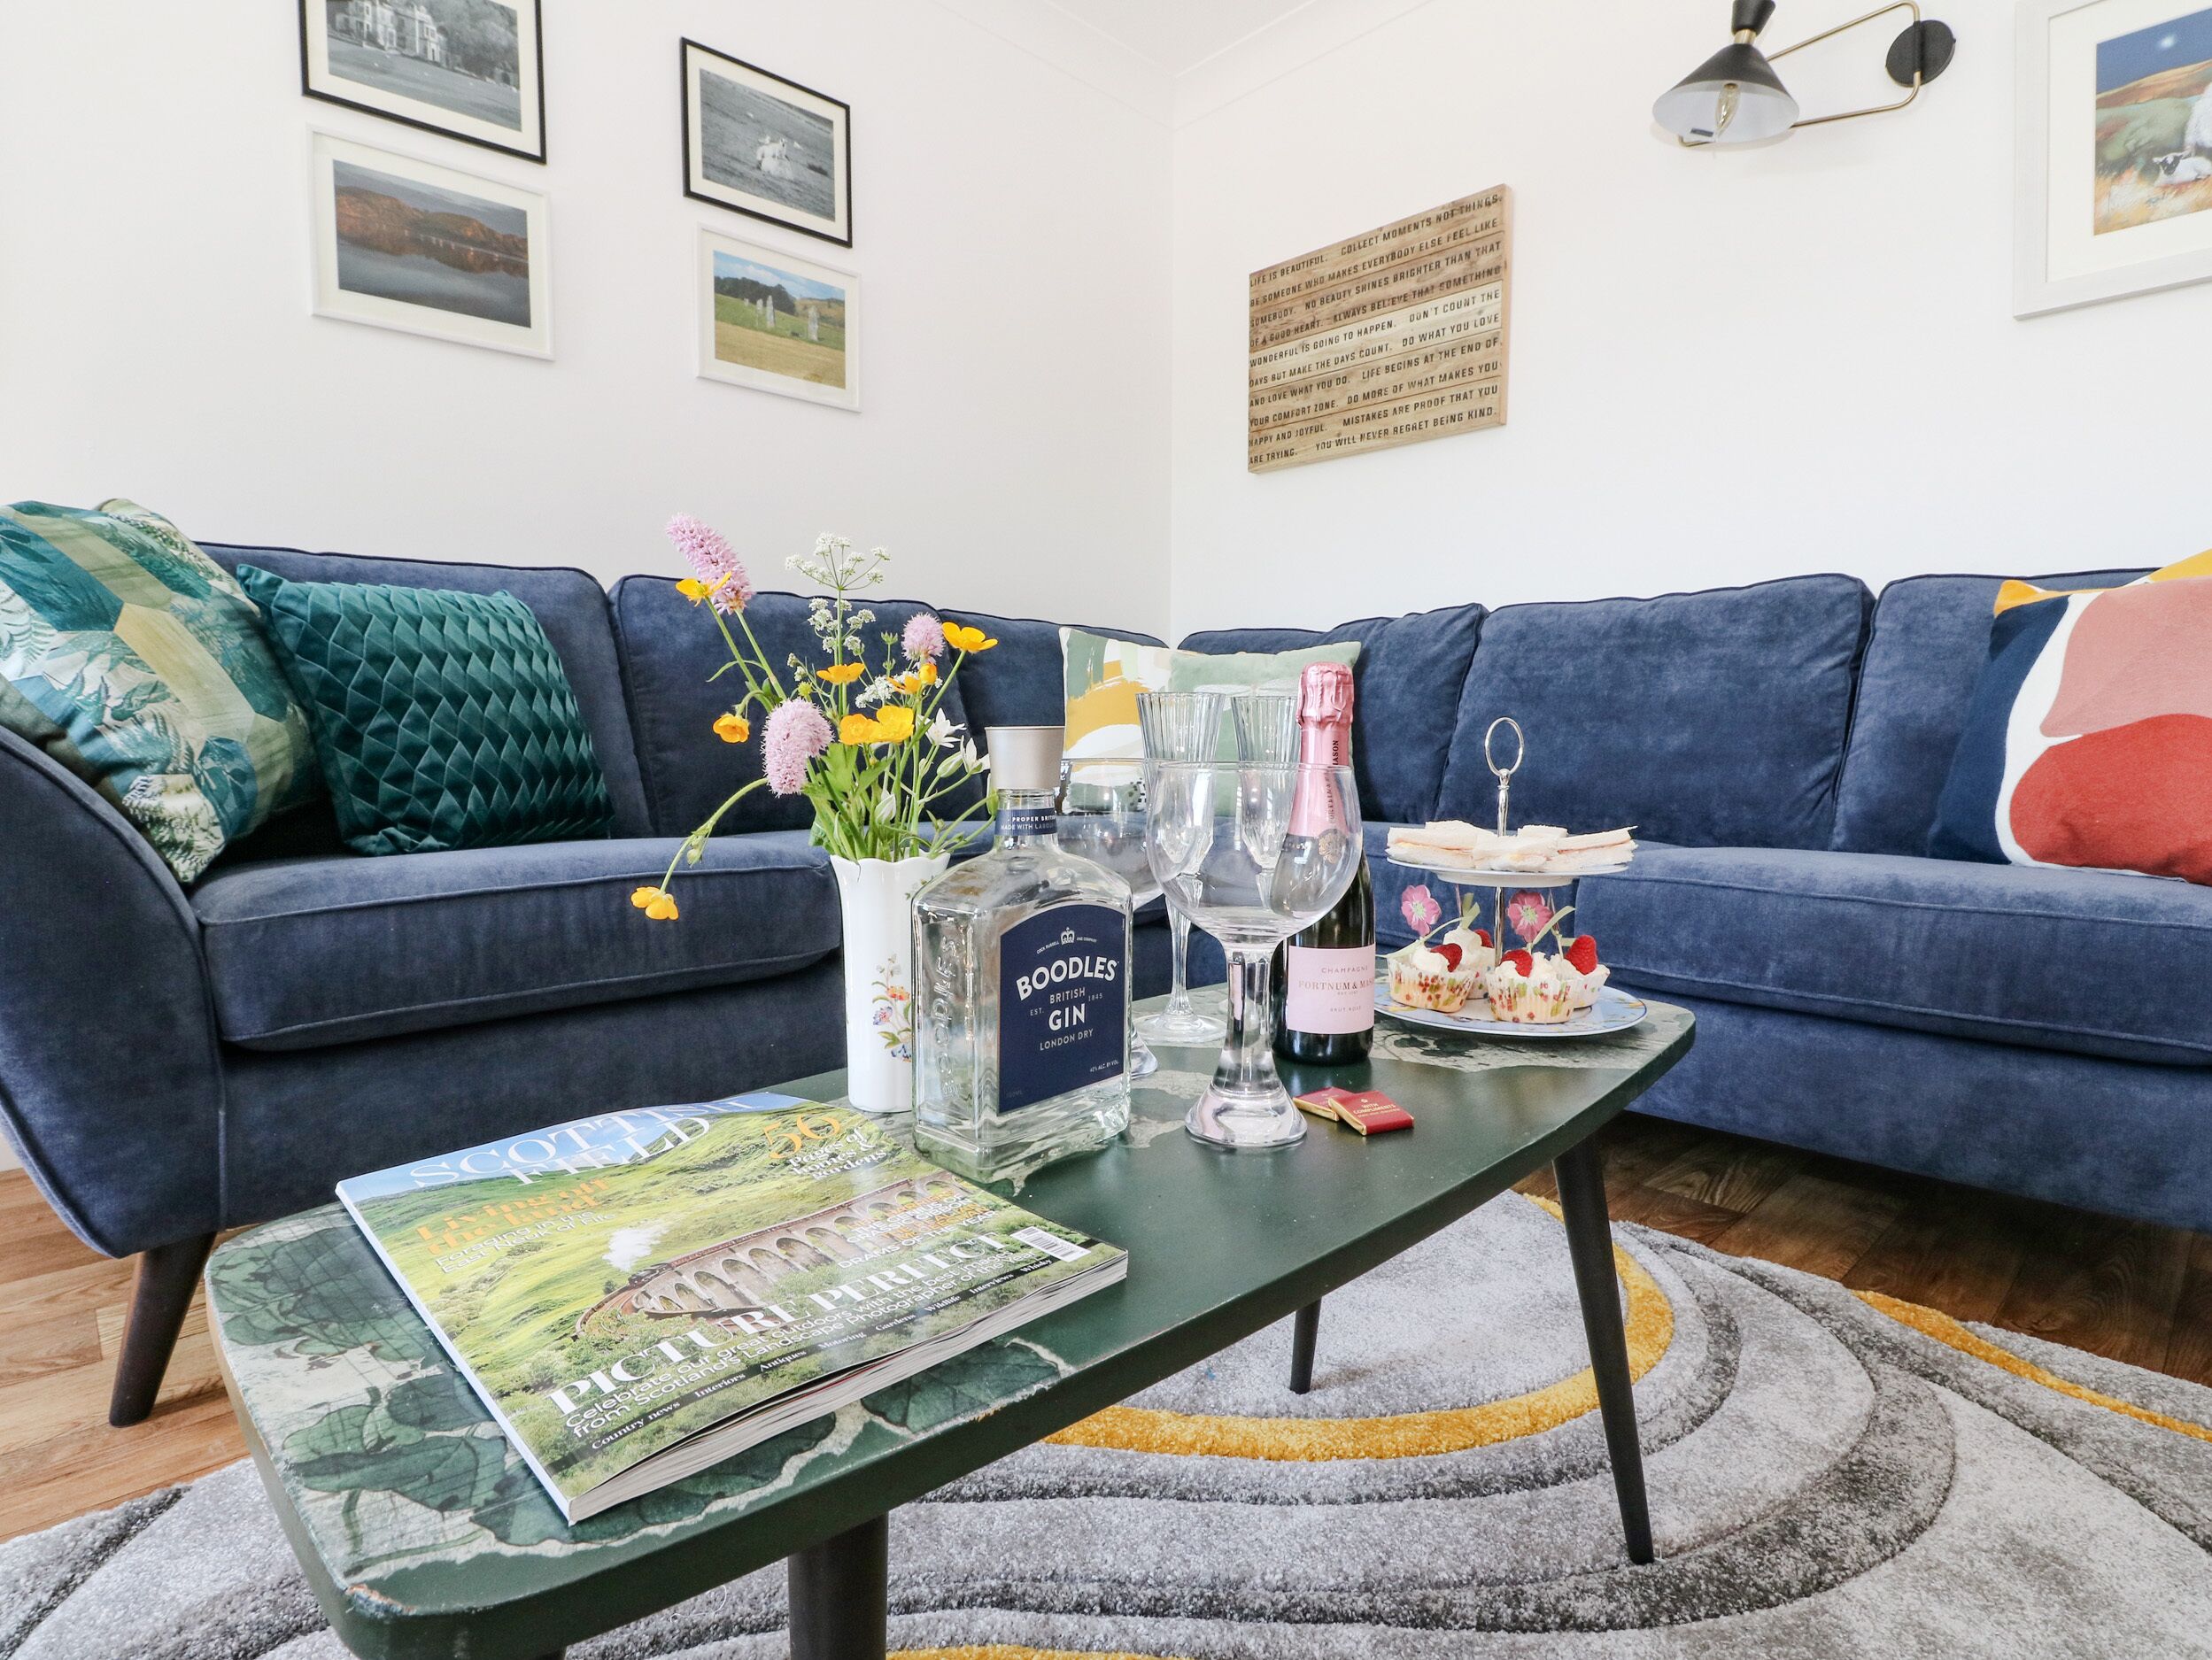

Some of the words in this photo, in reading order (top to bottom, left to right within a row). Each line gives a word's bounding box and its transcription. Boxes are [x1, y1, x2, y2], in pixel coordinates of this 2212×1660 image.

[1250, 275, 1266, 288] LIFE
[1269, 272, 1277, 281] IS
[1280, 255, 1328, 277] BEAUTIFUL.
[1342, 236, 1379, 256] COLLECT
[1383, 217, 1431, 241] MOMENTS
[1436, 209, 1455, 223] NOT
[1250, 297, 1259, 307] BE
[1263, 283, 1303, 304] SOMEONE
[1305, 276, 1325, 290] WHO
[1328, 265, 1358, 282] MAKES
[1362, 246, 1415, 271] EVERYBODY
[1419, 237, 1442, 251] ELSE
[1447, 228, 1471, 243] FEEL
[1475, 218, 1497, 233] LIKE
[1305, 299, 1317, 310] NO
[1320, 289, 1351, 305] BEAUTY
[1356, 277, 1389, 295] SHINES
[1393, 260, 1441, 282] BRIGHTER
[1445, 251, 1471, 266] THAN
[1476, 241, 1501, 256] THAT
[1250, 338, 1259, 347] OF
[1270, 329, 1291, 342] GOOD
[1334, 305, 1366, 323] ALWAYS
[1371, 293, 1409, 312] BELIEVE
[1412, 285, 1435, 299] THAT
[1439, 266, 1502, 290] SOMETHING
[1250, 348, 1299, 367] WONDERFUL
[1302, 344, 1311, 352] IS
[1313, 336, 1340, 350] GOING
[1344, 332, 1354, 341] TO
[1443, 296, 1476, 313] COUNT
[1481, 290, 1499, 302] THE
[1249, 376, 1269, 388] DAYS
[1272, 371, 1287, 382] BUT
[1289, 364, 1312, 377] MAKE
[1316, 359, 1331, 370] THE
[1334, 352, 1356, 366] DAYS
[1403, 336, 1414, 346] DO
[1419, 328, 1446, 343] WHAT
[1450, 321, 1469, 334] YOU
[1474, 313, 1499, 328] LOVE
[1250, 397, 1265, 407] AND
[1268, 391, 1287, 403] LOVE
[1290, 384, 1313, 397] WHAT
[1317, 380, 1332, 390] YOU
[1362, 367, 1381, 380] LIFE
[1385, 357, 1419, 374] BEGINS
[1424, 354, 1435, 364] AT
[1438, 348, 1457, 360] THE
[1461, 342, 1481, 355] END
[1486, 337, 1499, 349] OF
[1250, 416, 1269, 427] YOUR
[1272, 405, 1311, 422] COMFORT
[1348, 394, 1358, 405] DO
[1363, 387, 1388, 401] MORE
[1393, 383, 1404, 394] OF
[1408, 375, 1435, 390] WHAT
[1439, 367, 1473, 382] MAKES
[1478, 361, 1498, 374] YOU
[1276, 430, 1292, 441] AND
[1343, 409, 1388, 426] MISTAKES
[1393, 404, 1410, 416] ARE
[1414, 396, 1446, 411] PROOF
[1450, 390, 1474, 403] THAT
[1478, 385, 1498, 397] YOU
[1316, 440, 1332, 451] YOU
[1335, 434, 1357, 447] WILL
[1360, 429, 1388, 442] NEVER
[1393, 421, 1429, 436] REGRET
[1434, 413, 1463, 427] BEING
[1016, 956, 1117, 1001] BOODLES
[1049, 986, 1086, 1004] BRITISH
[1088, 992, 1103, 1002] 1845
[1298, 980, 1350, 991] FORTNUM
[1321, 965, 1368, 974] CHAMPAGNE
[1040, 1033, 1075, 1051] LONDON
[1078, 1028, 1094, 1040] DRY
[1048, 1003, 1086, 1031] GIN
[515, 1116, 710, 1187] FIELD
[435, 1227, 531, 1266] Foraging
[442, 1248, 491, 1274] East
[836, 1244, 901, 1269] DRAMS
[898, 1235, 927, 1247] OF
[923, 1224, 959, 1238] THE
[546, 1298, 812, 1418] PICTURE
[807, 1231, 1010, 1311] PERFECT
[566, 1373, 674, 1428] Celebrate
[677, 1352, 712, 1374] our
[716, 1332, 770, 1360] great
[771, 1309, 850, 1339] outdoors
[852, 1295, 894, 1316] with
[896, 1282, 923, 1299] the
[924, 1269, 961, 1287] best
[962, 1250, 1016, 1275] images
[573, 1405, 631, 1439] from
[634, 1357, 741, 1406] Scotland's
[743, 1322, 846, 1360] Landscape
[849, 1278, 959, 1326] Photographer
[960, 1269, 979, 1283] of
[978, 1261, 1006, 1278] the
[1004, 1250, 1035, 1268] Year
[592, 1418, 645, 1449] Country
[647, 1401, 682, 1422] news
[693, 1371, 746, 1399] Interiors
[759, 1350, 808, 1373] Antiques
[817, 1331, 868, 1351] Motoring
[875, 1313, 917, 1332] Gardens
[924, 1294, 962, 1313] Wildlife
[969, 1274, 1015, 1296] Interviews
[1019, 1259, 1052, 1275] Whisky
